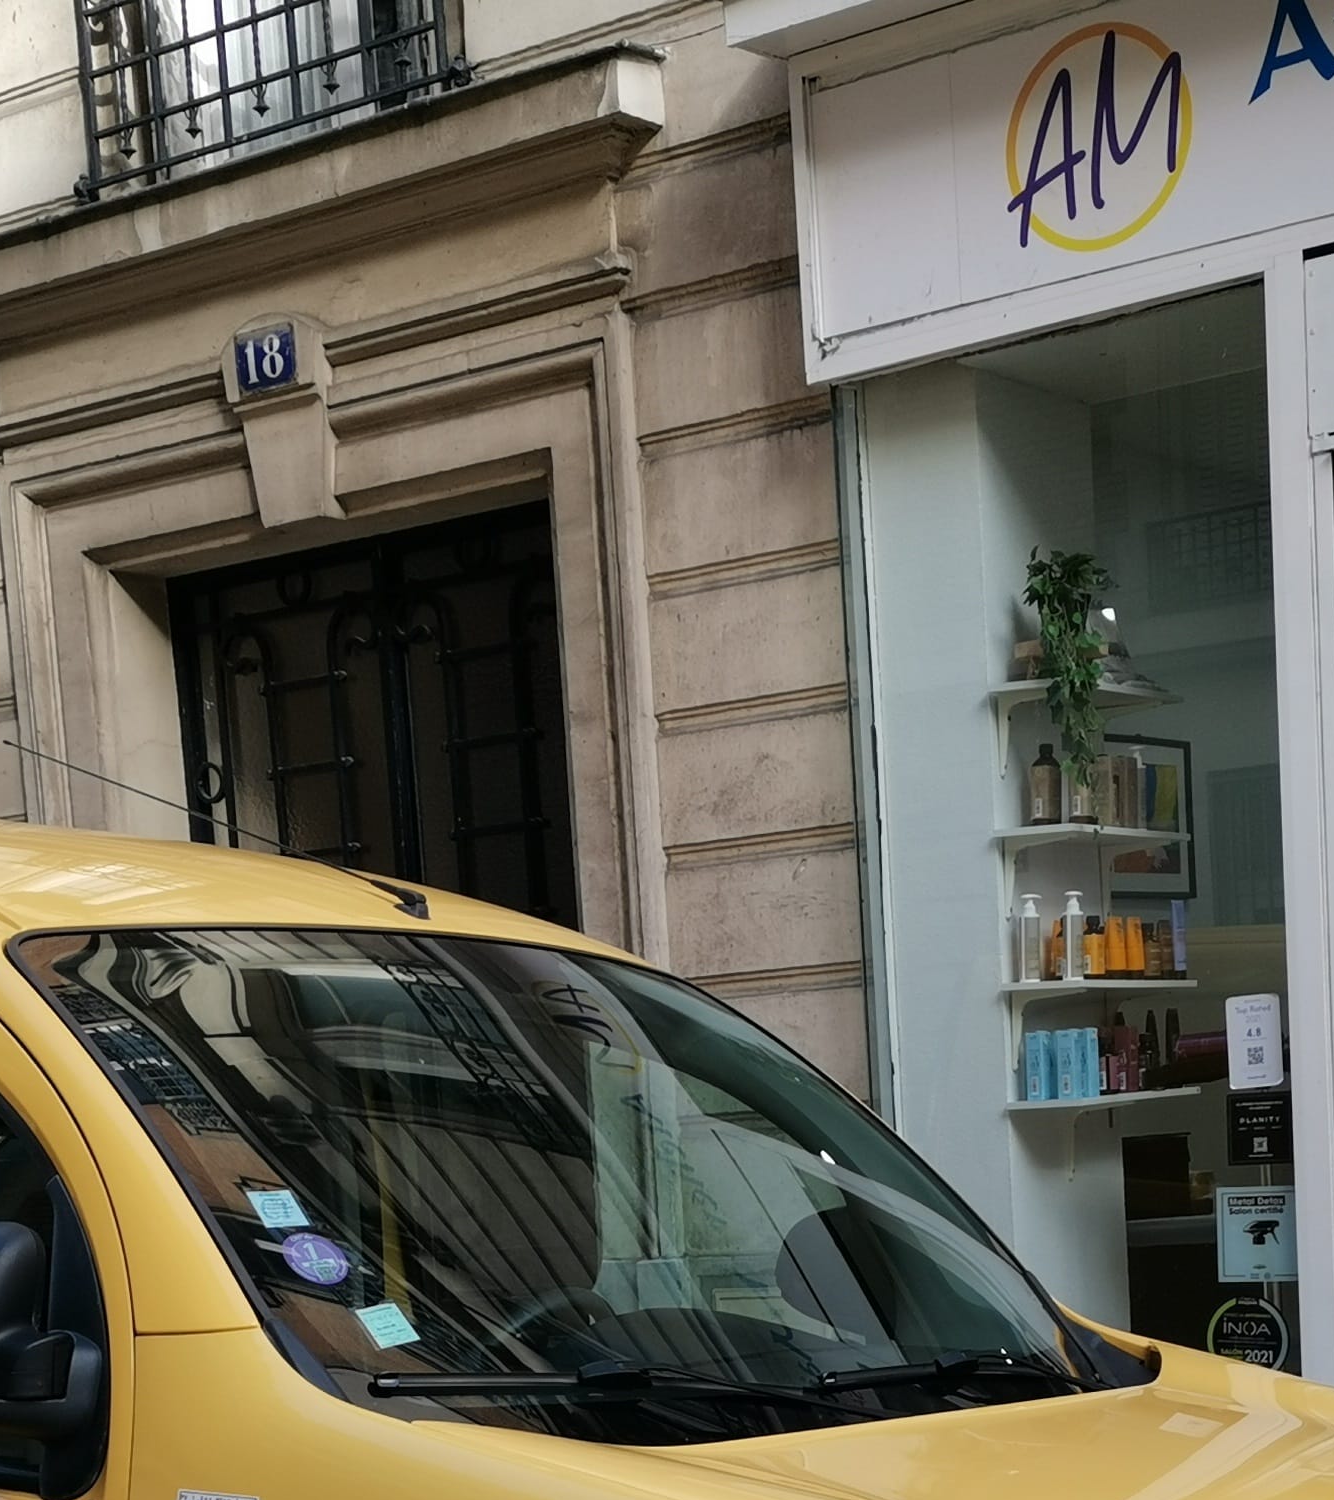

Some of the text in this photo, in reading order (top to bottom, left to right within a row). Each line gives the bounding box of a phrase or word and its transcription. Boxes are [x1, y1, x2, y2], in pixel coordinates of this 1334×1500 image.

[1007, 30, 1181, 247] AM
[244, 334, 285, 384] 18
[1247, 1027, 1261, 1037] 4.8
[1229, 1197, 1283, 1206] Metal Detox
[1229, 1207, 1253, 1215] Salon
[1244, 1350, 1274, 1363] 2021
